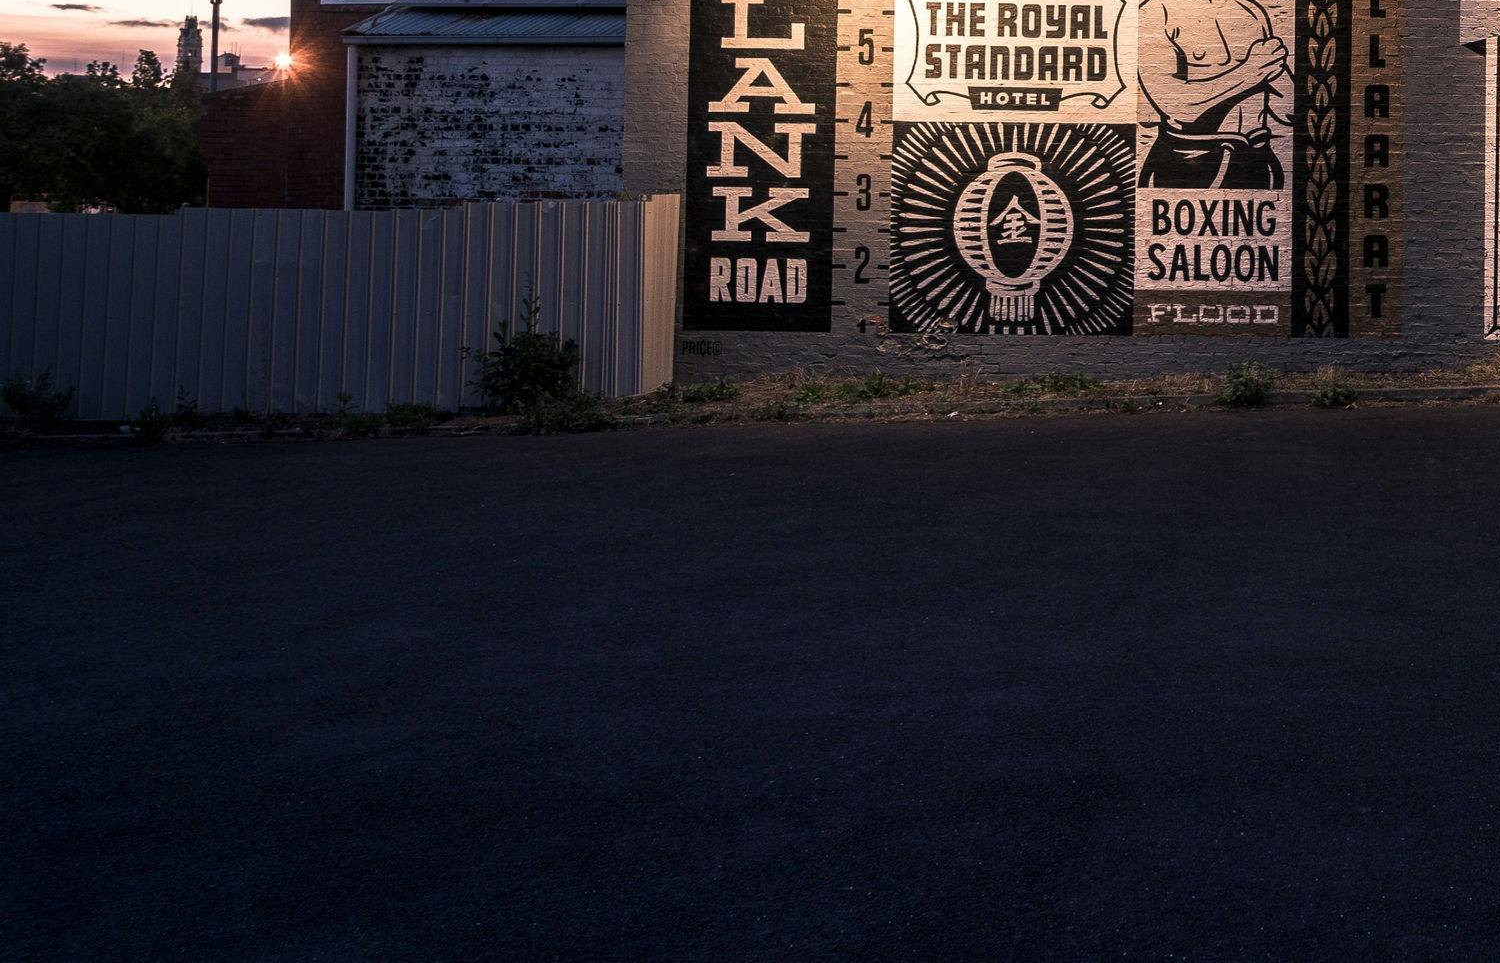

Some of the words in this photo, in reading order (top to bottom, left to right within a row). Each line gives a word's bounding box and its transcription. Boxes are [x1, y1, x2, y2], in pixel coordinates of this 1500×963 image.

[926, 2, 984, 38] THE
[997, 3, 1107, 39] ROYAL
[858, 29, 874, 66] 5
[925, 44, 1107, 81] STANDARD
[980, 91, 1051, 106] HOTEL
[855, 101, 873, 138] 4
[855, 174, 871, 211] 3
[992, 195, 1041, 245] 金
[1152, 199, 1276, 236] BOXING
[709, 258, 807, 304] ROAD
[854, 246, 870, 284] 2
[1147, 243, 1279, 282] SALOON
[1147, 303, 1279, 325] FLOOD
